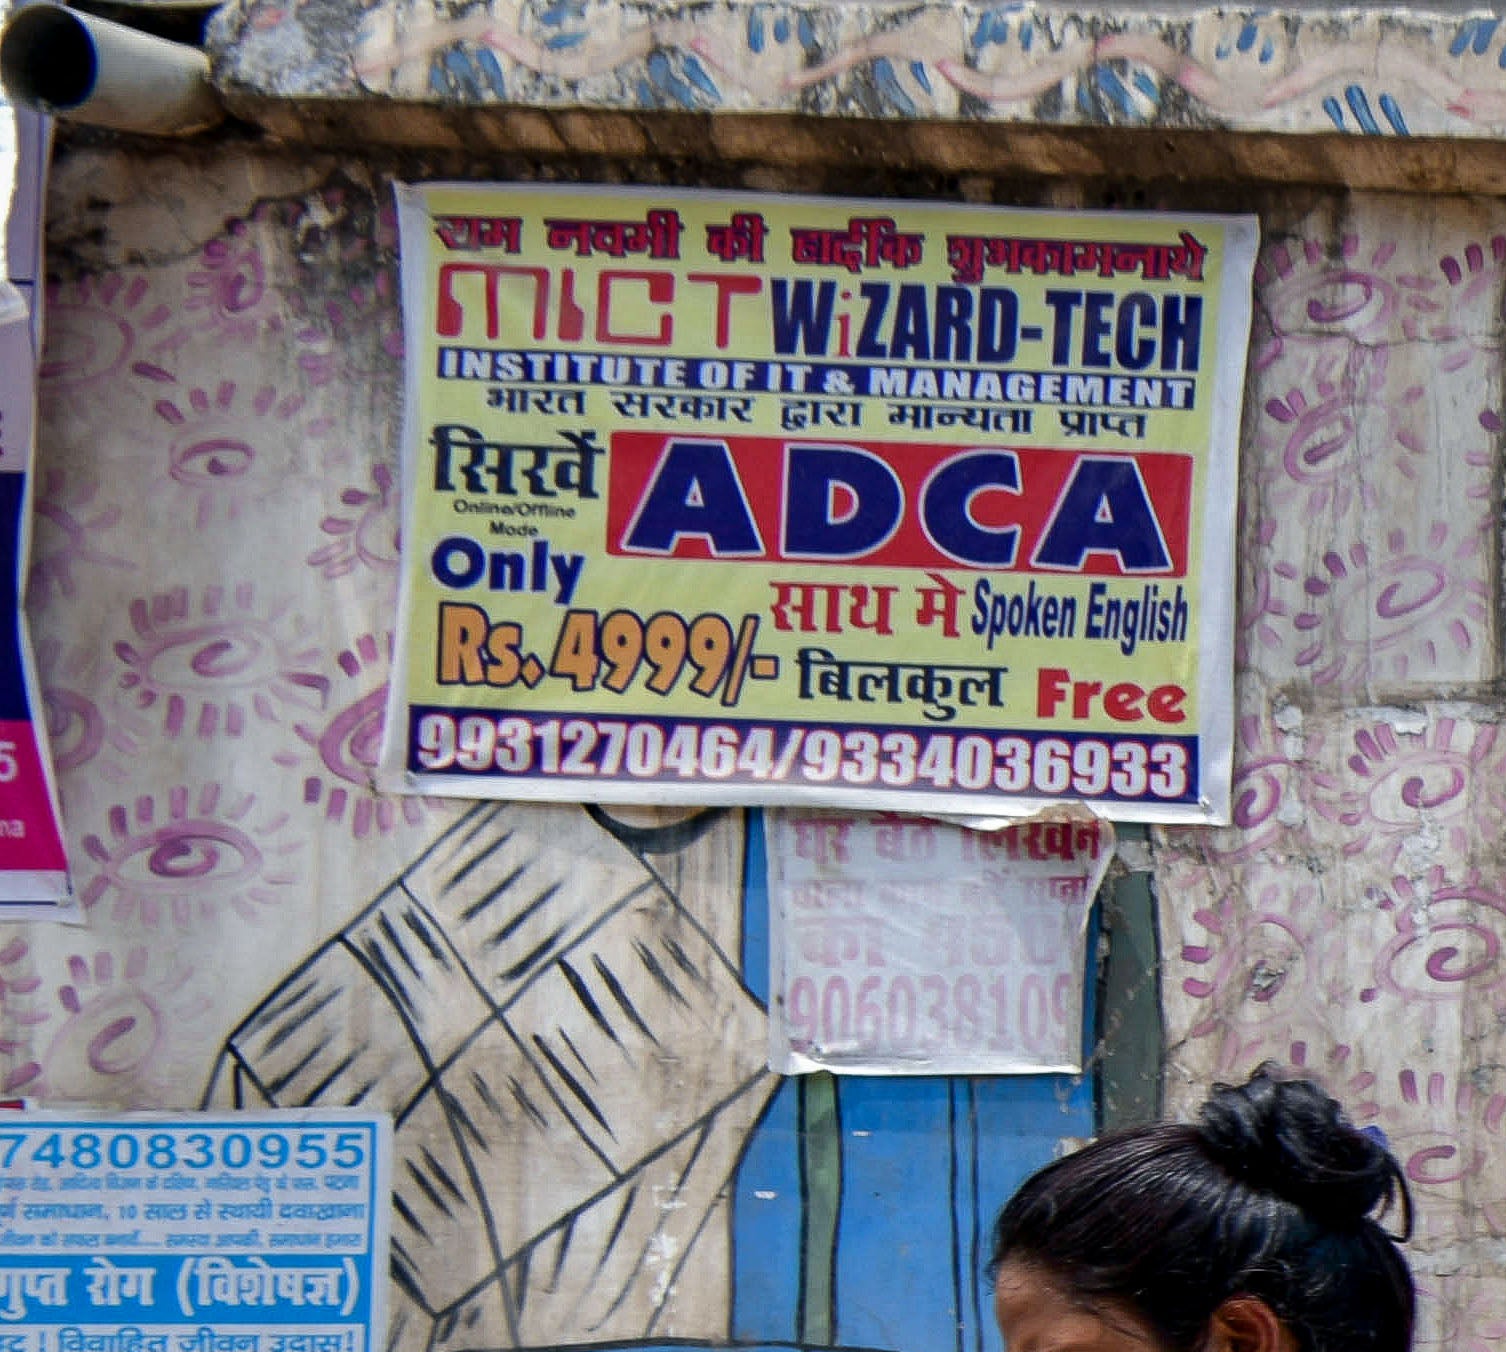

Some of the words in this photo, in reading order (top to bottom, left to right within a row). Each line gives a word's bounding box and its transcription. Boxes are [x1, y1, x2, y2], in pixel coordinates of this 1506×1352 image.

[544, 209, 684, 259] नवमी
[706, 212, 768, 263] की
[441, 349, 687, 387] INSTITUTE
[699, 356, 754, 388] OF
[768, 362, 812, 391] IT
[823, 368, 856, 393] &
[868, 368, 1193, 409] MANAGEMENT
[487, 388, 587, 416] भारत
[610, 391, 756, 421] सरकार
[780, 396, 862, 430] द्वारा
[888, 403, 1034, 434] मान्यता
[1060, 409, 1148, 439] प्राप्त
[453, 499, 576, 519] Online/Offline
[489, 521, 539, 537] Mode
[619, 436, 1174, 575] ADCA
[431, 536, 586, 605] Only
[769, 581, 898, 635] साथ
[971, 577, 1077, 650] Spoken
[1085, 581, 1190, 656] English
[437, 601, 546, 689] Rs.
[549, 608, 780, 707] 4999/-
[794, 647, 1008, 721] बिलकुल
[1036, 667, 1188, 724] Free
[416, 714, 1188, 799] 9931270464/9334036933
[83, 1257, 156, 1307] रोग
[177, 1256, 361, 1317] (विशेषज्ञ)
